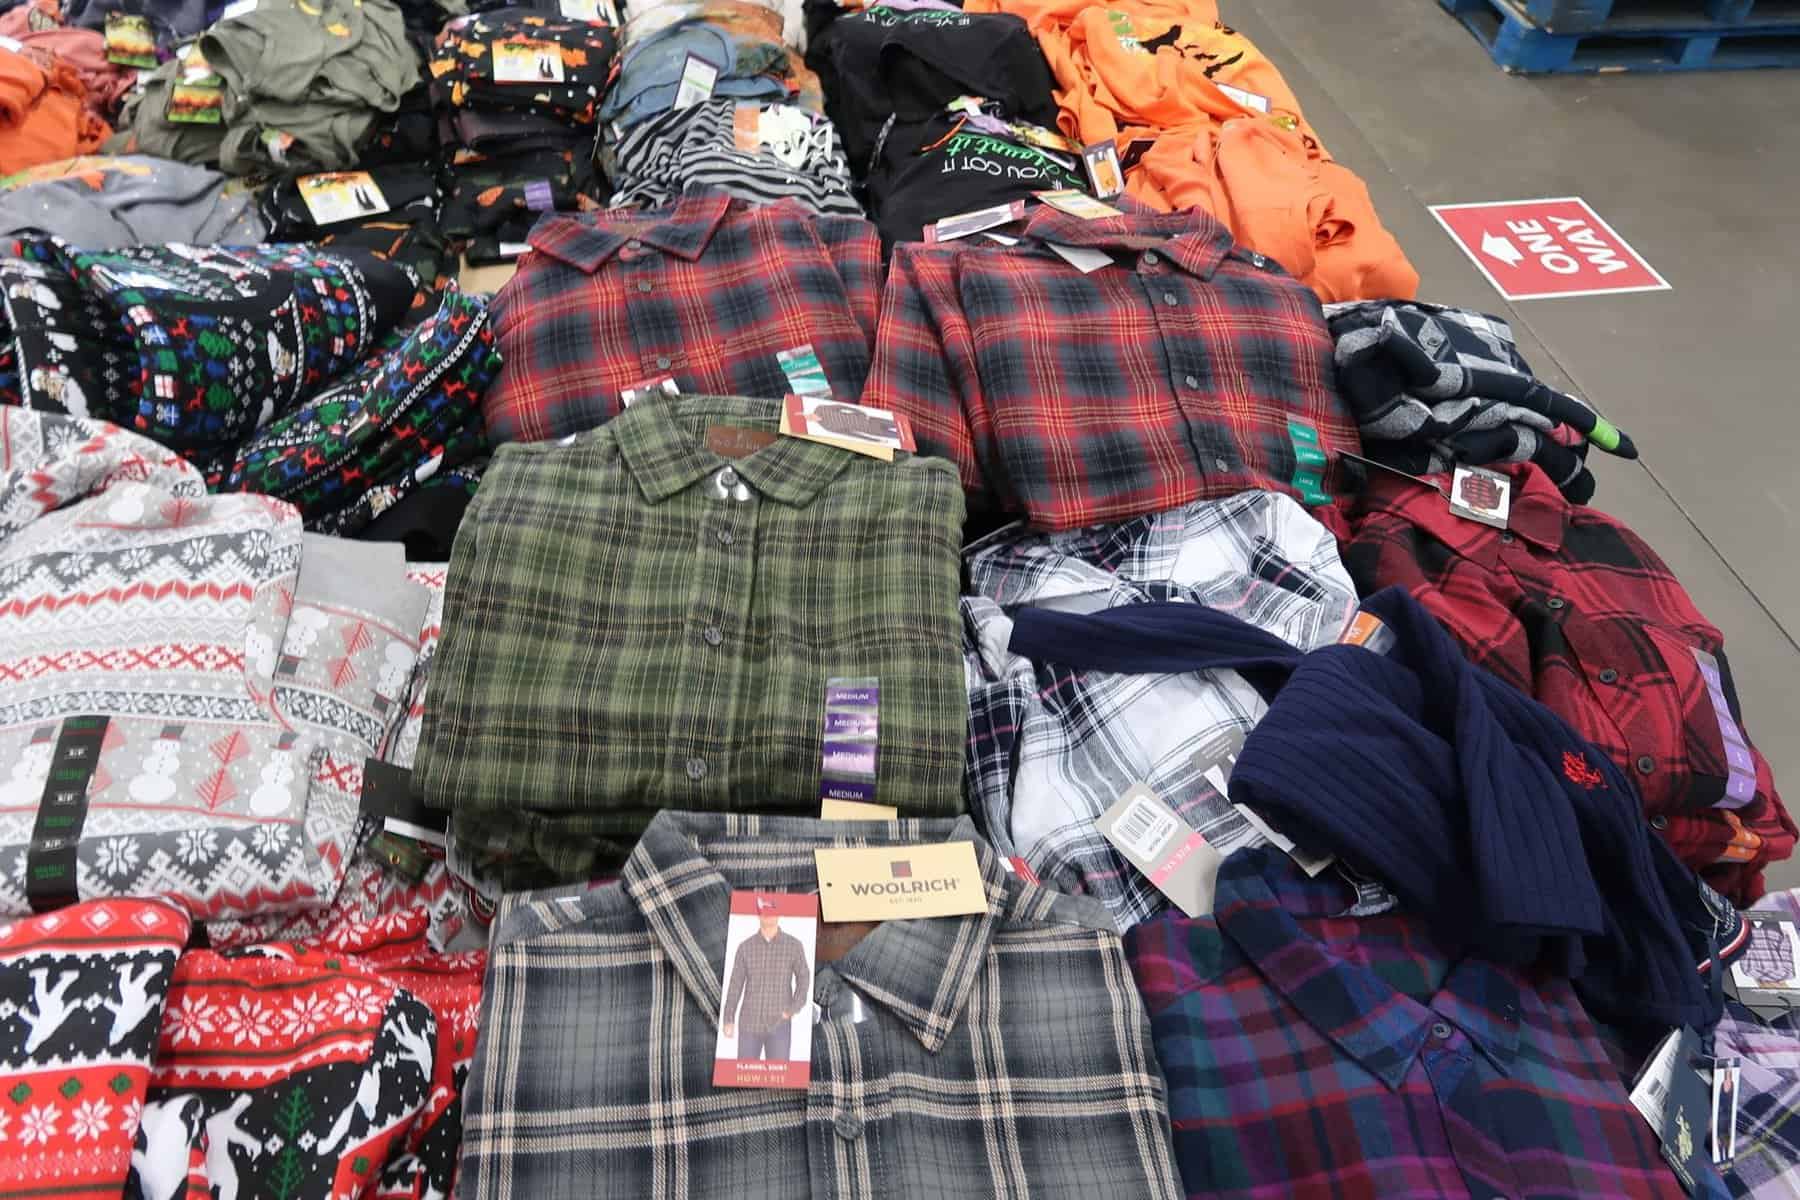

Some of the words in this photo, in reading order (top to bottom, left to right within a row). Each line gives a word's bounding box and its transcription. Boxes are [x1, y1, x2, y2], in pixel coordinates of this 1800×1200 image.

[942, 158, 955, 173] IT
[961, 156, 1002, 175] GOT
[1007, 165, 1049, 179] YOU
[1505, 219, 1580, 274] ONE
[1546, 215, 1629, 274] WAY
[836, 692, 869, 700] MEDIUM
[834, 719, 867, 728] MEDIUM
[833, 750, 865, 760] MEDIUM
[828, 788, 864, 800] MEDIUM
[851, 877, 958, 897] WOOLRICH
